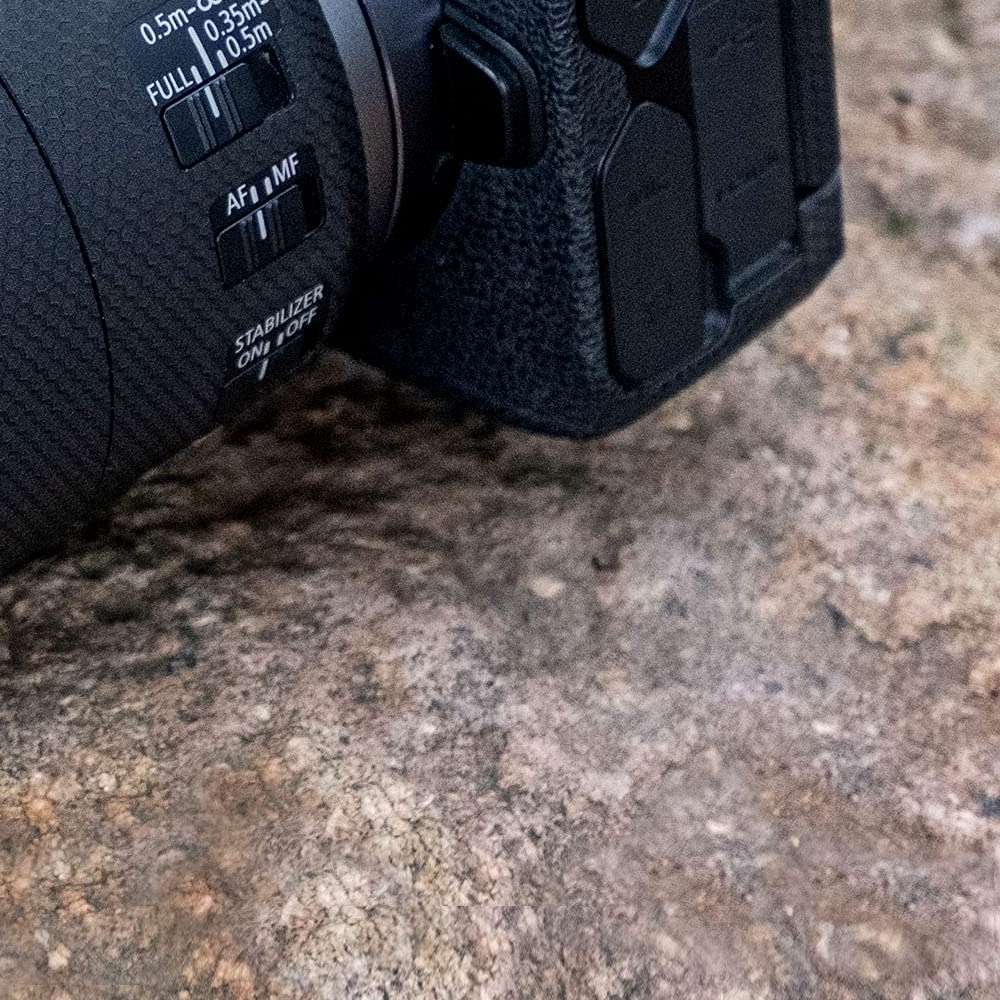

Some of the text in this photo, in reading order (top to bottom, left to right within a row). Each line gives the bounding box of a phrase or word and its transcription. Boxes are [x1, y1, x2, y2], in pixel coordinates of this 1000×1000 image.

[226, 21, 273, 58] 0.5m
[146, 67, 193, 107] FULL
[271, 152, 300, 187] MF
[227, 183, 247, 216] AF
[235, 283, 325, 354] STABILIZER
[285, 306, 319, 338] OFF
[237, 341, 265, 369] ON
